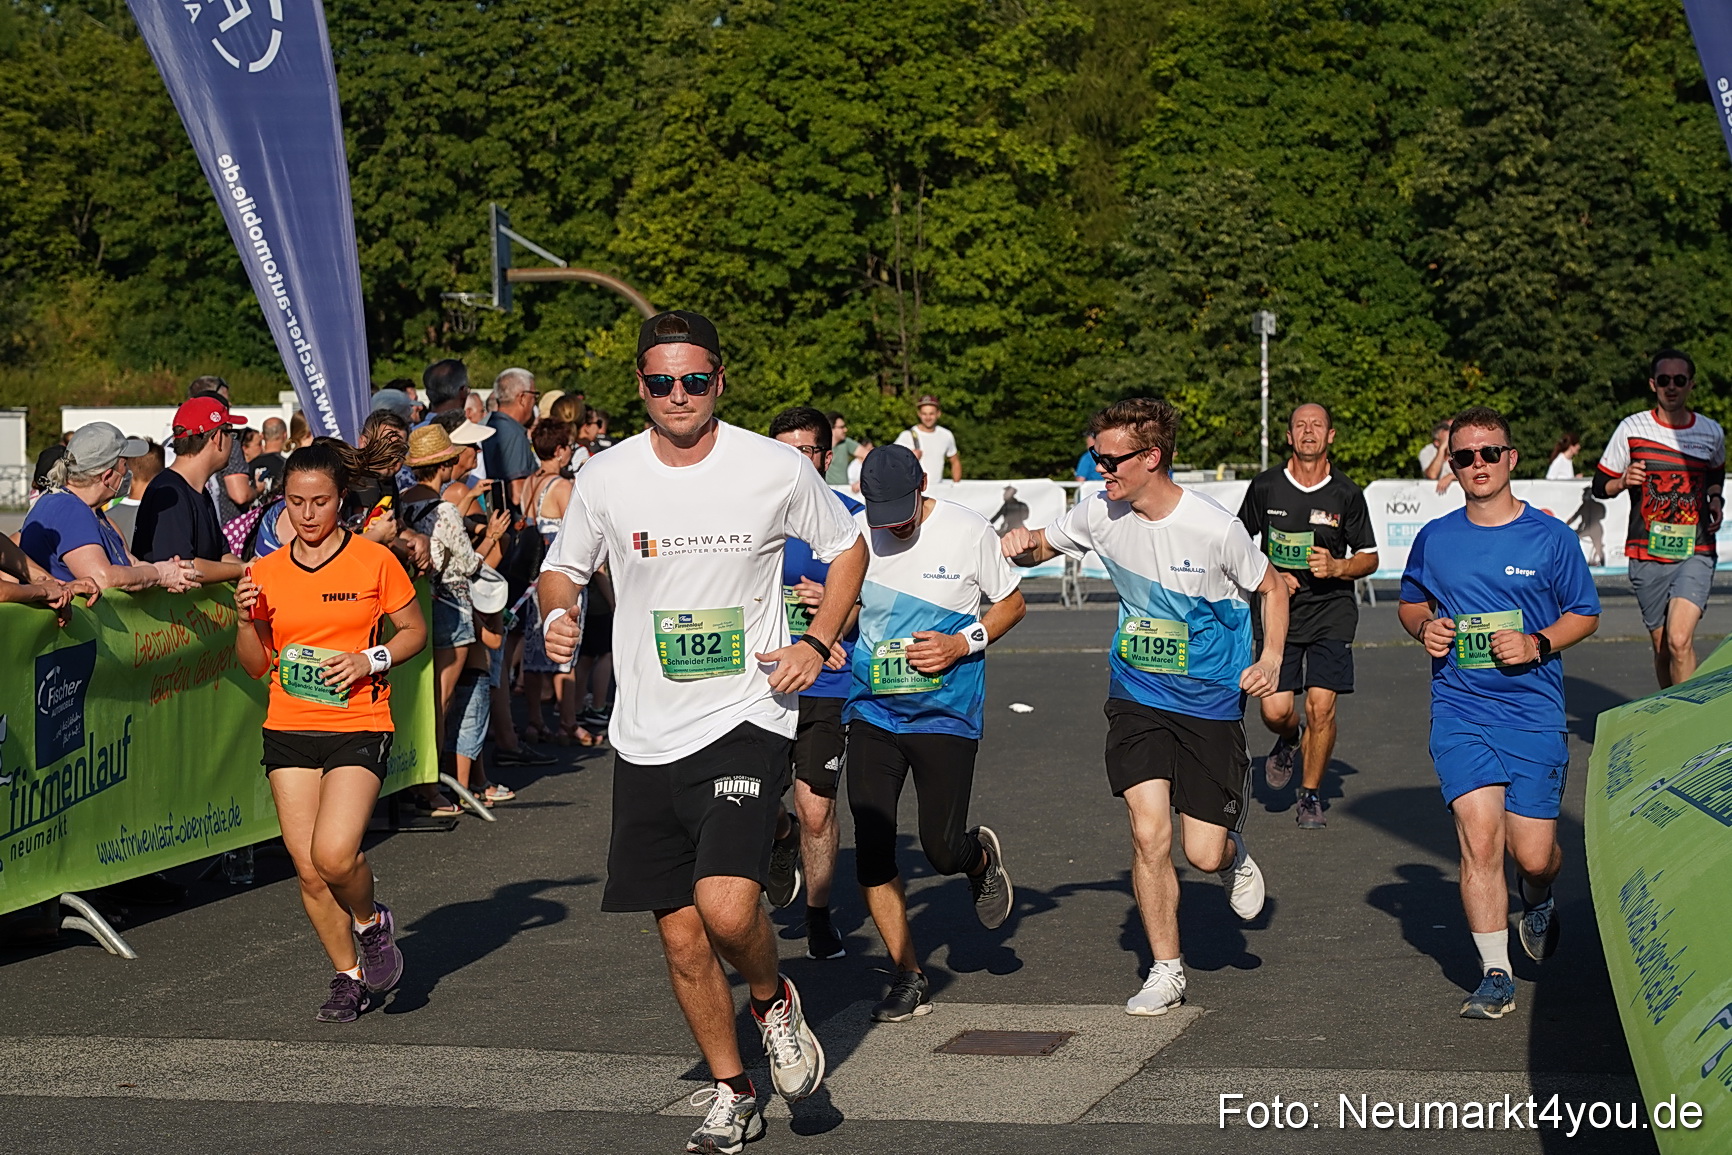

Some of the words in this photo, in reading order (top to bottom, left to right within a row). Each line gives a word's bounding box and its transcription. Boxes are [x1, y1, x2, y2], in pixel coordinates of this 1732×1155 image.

[1387, 502, 1421, 514] NOW
[661, 535, 753, 548] SCHWARZ
[1660, 535, 1684, 548] 123
[661, 548, 709, 557] COMPUTER
[1275, 544, 1301, 558] 419
[1515, 567, 1536, 577] Berger
[321, 592, 358, 602] THULE
[675, 632, 722, 657] 182
[731, 633, 741, 665] 2022
[1129, 635, 1178, 656] 1195
[667, 657, 705, 666] Schneider
[706, 654, 733, 664] Florian
[1131, 653, 1150, 662] Waas
[1150, 655, 1174, 664] Marcel
[1177, 642, 1186, 667] 2022
[282, 665, 290, 686] RUN
[873, 664, 881, 684] RUN
[881, 676, 910, 684] Bönisch
[48, 679, 82, 708] Fischer
[10, 714, 132, 833] firmenlauf
[714, 780, 760, 796] PUMA
[11, 814, 68, 861] neumarkt
[96, 796, 243, 865] www.firmenlauf-oberpfalz.de
